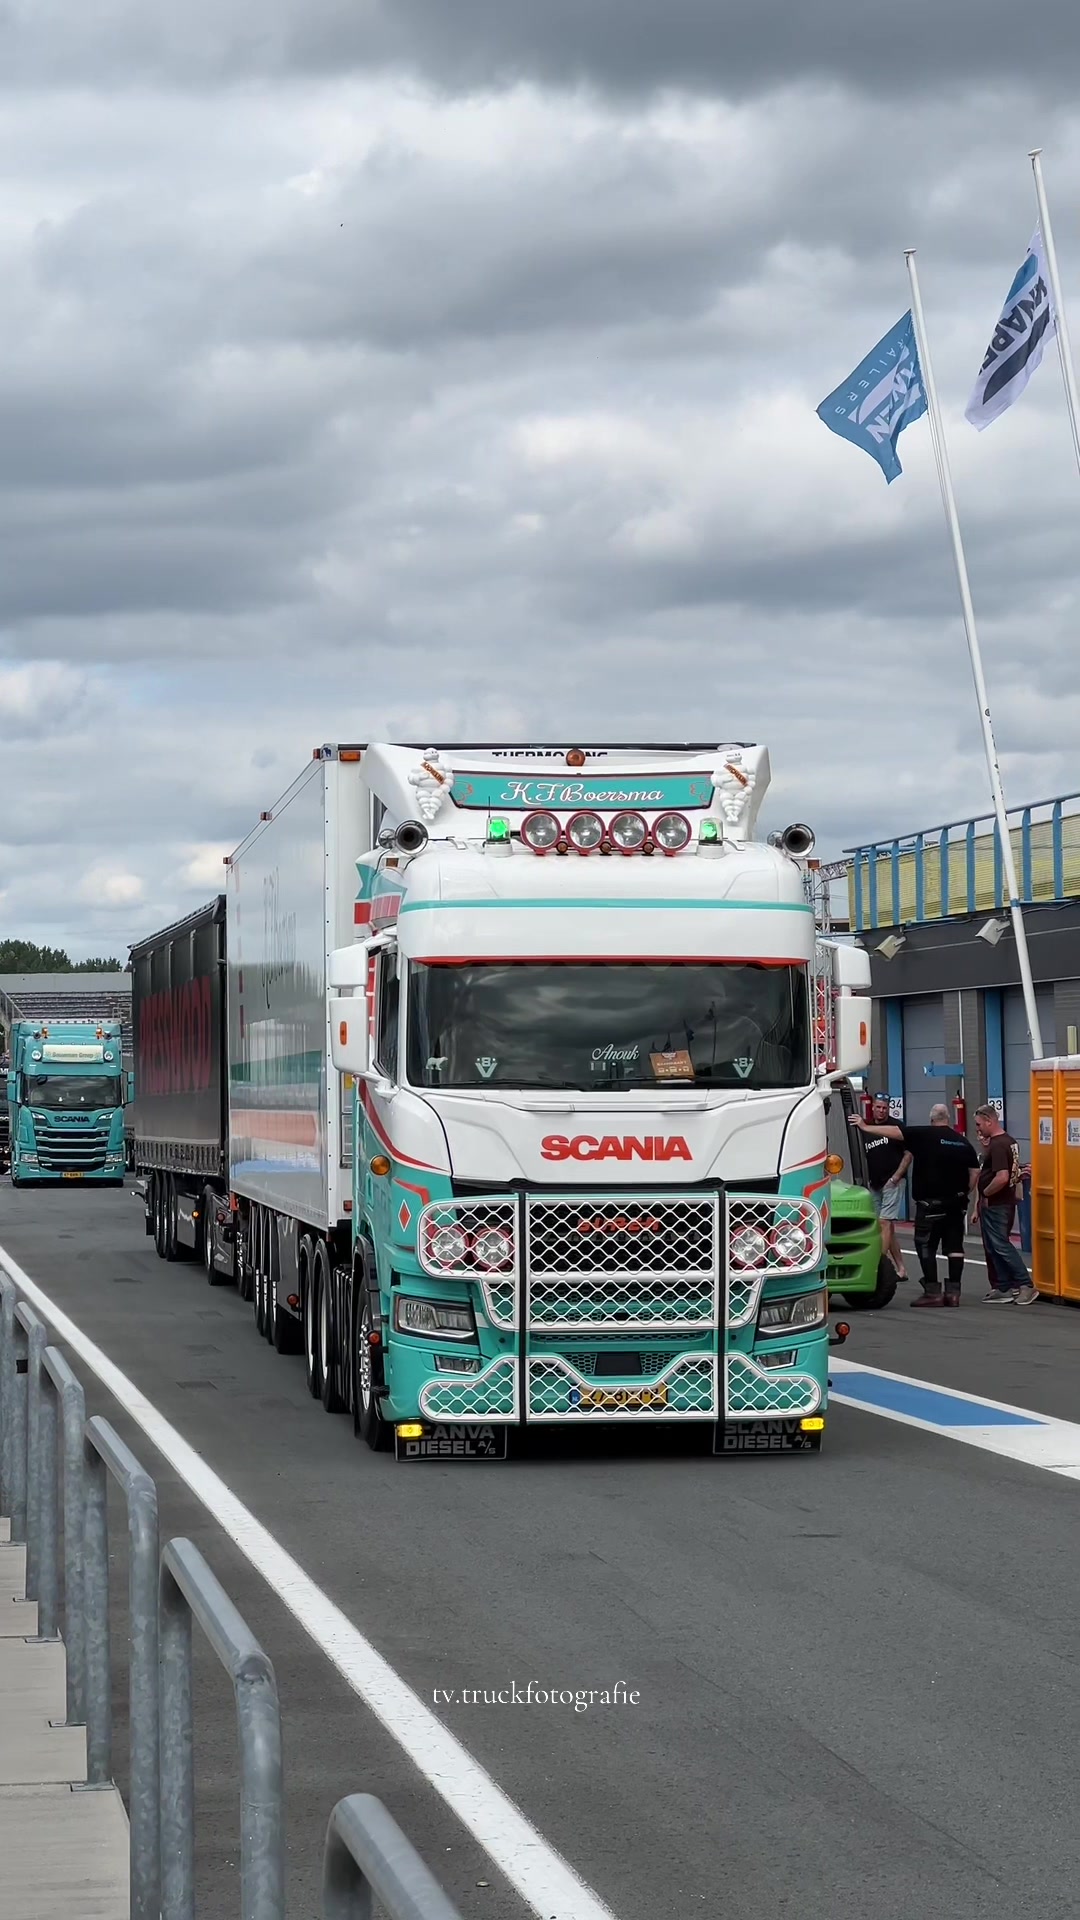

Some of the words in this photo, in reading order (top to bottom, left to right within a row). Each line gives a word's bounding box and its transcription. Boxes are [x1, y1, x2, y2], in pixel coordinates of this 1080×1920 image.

[834, 330, 911, 415] RAILERS
[591, 1043, 640, 1061] Anouk
[889, 1099, 902, 1109] 34
[989, 1100, 1003, 1110] 33
[54, 1115, 90, 1123] SCANIA
[540, 1134, 694, 1161] SCANIA
[406, 1440, 476, 1456] DIESEL
[723, 1435, 793, 1449] DIESEL
